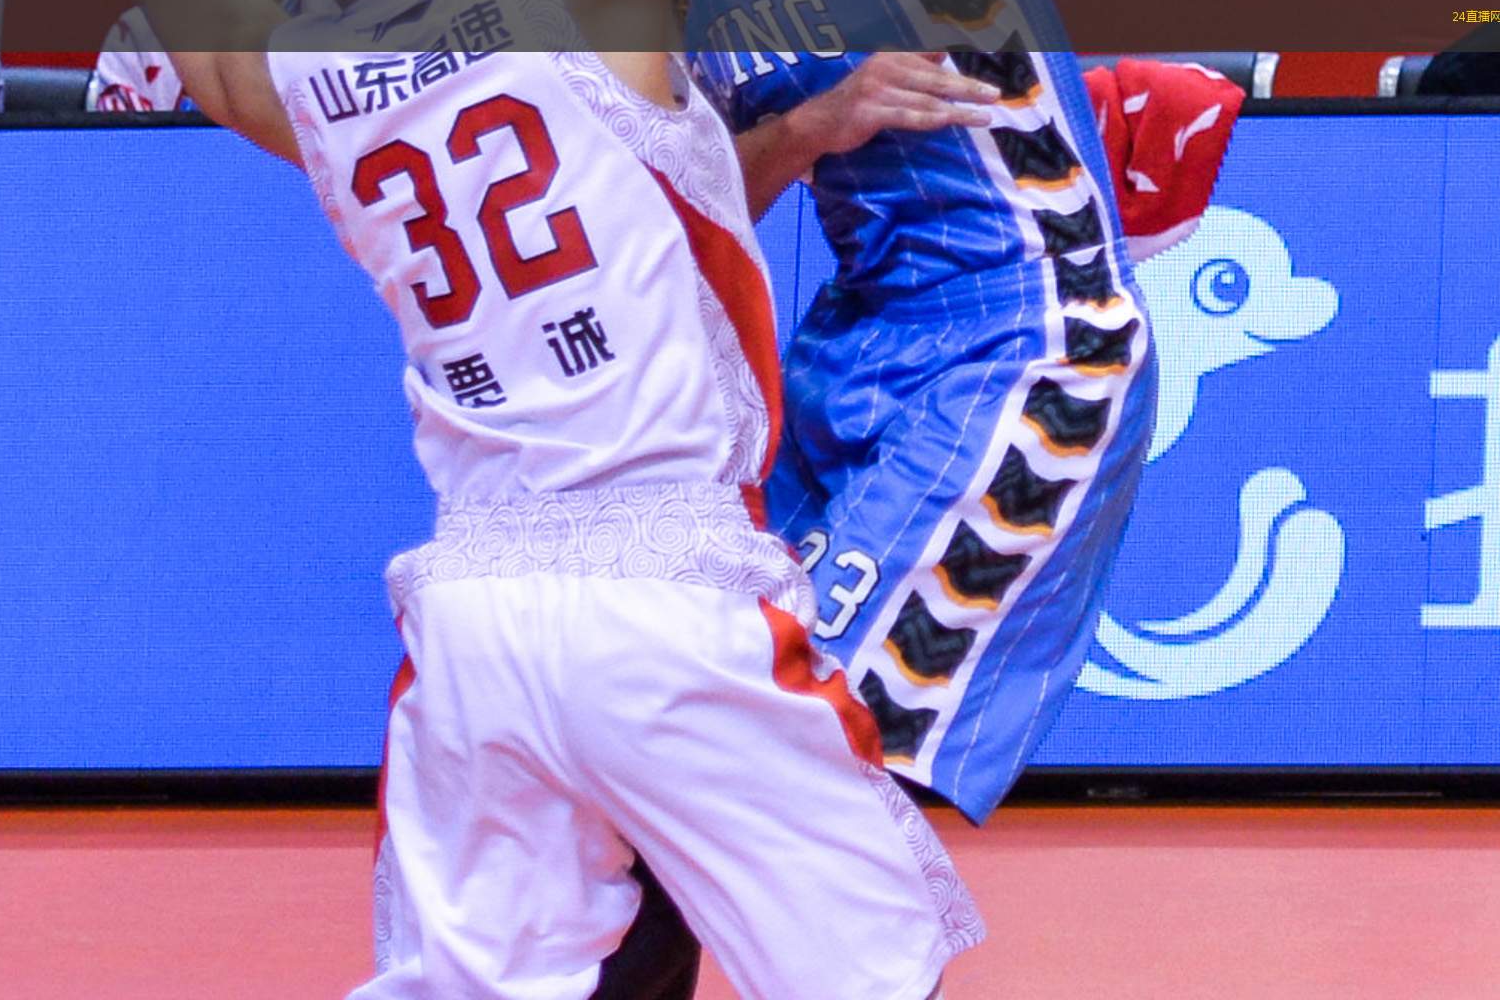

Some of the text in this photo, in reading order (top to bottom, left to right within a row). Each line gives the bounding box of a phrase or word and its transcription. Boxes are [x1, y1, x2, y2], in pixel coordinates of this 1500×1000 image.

[309, 0, 514, 123] 山东高速
[350, 93, 599, 330] 32
